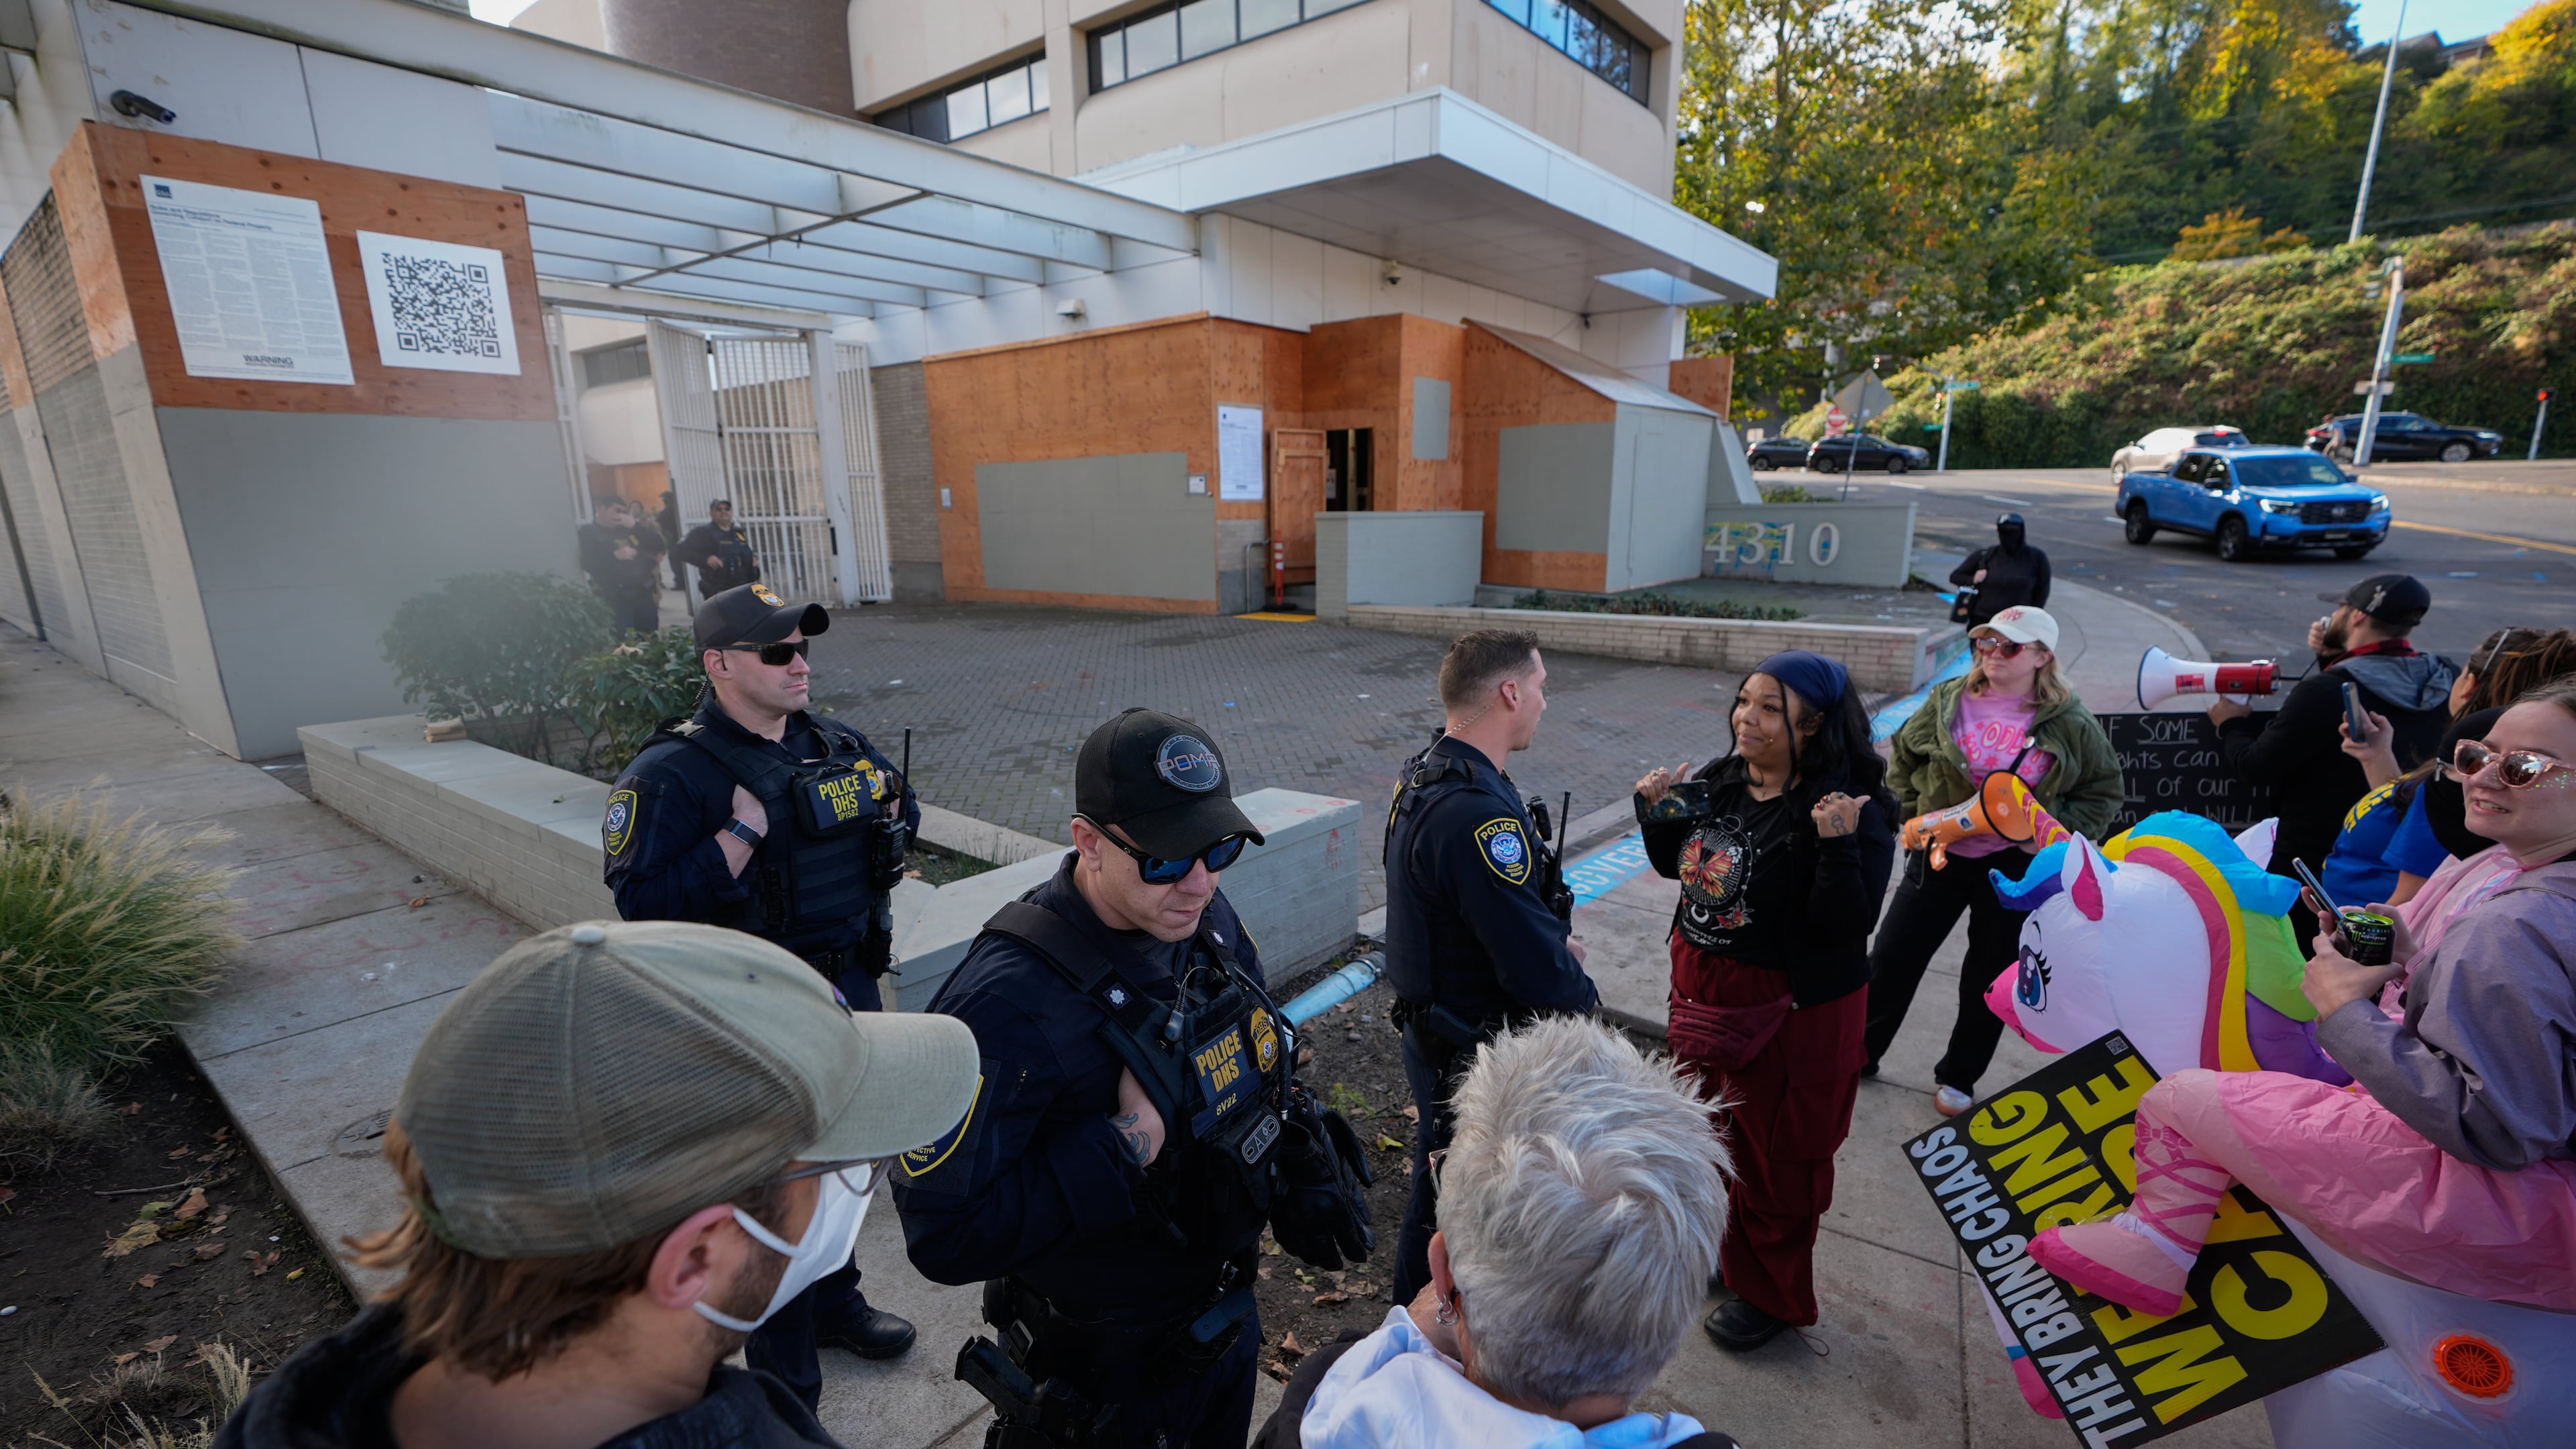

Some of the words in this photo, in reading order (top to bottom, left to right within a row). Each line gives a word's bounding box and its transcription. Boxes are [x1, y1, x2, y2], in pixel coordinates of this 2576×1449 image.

[242, 354, 294, 365] WARNING
[1705, 522, 1839, 566] 4310
[2139, 715, 2198, 742] SOME
[1158, 753, 1221, 777] POMA
[818, 774, 861, 800] POLICE
[608, 794, 629, 806] POLICE
[832, 792, 858, 814] DHS
[837, 808, 859, 822] 8P1582
[1480, 822, 1517, 841] POLICE
[1563, 837, 1650, 895] GOVER
[1254, 1020, 1268, 1037] DHS
[1195, 1030, 1242, 1078] POLICE
[1212, 1058, 1240, 1093] DHS
[1216, 1093, 1238, 1116] 8V22
[907, 1150, 928, 1162] SERVICE
[914, 1146, 936, 1155] ECTIVE
[1254, 1135, 1265, 1152] A
[1910, 1126, 2010, 1240] CHAOS
[1968, 1090, 2127, 1296] RING
[2057, 1055, 2328, 1340] CE
[1976, 1234, 2084, 1352] BRING
[2037, 1344, 2147, 1449] THEY
